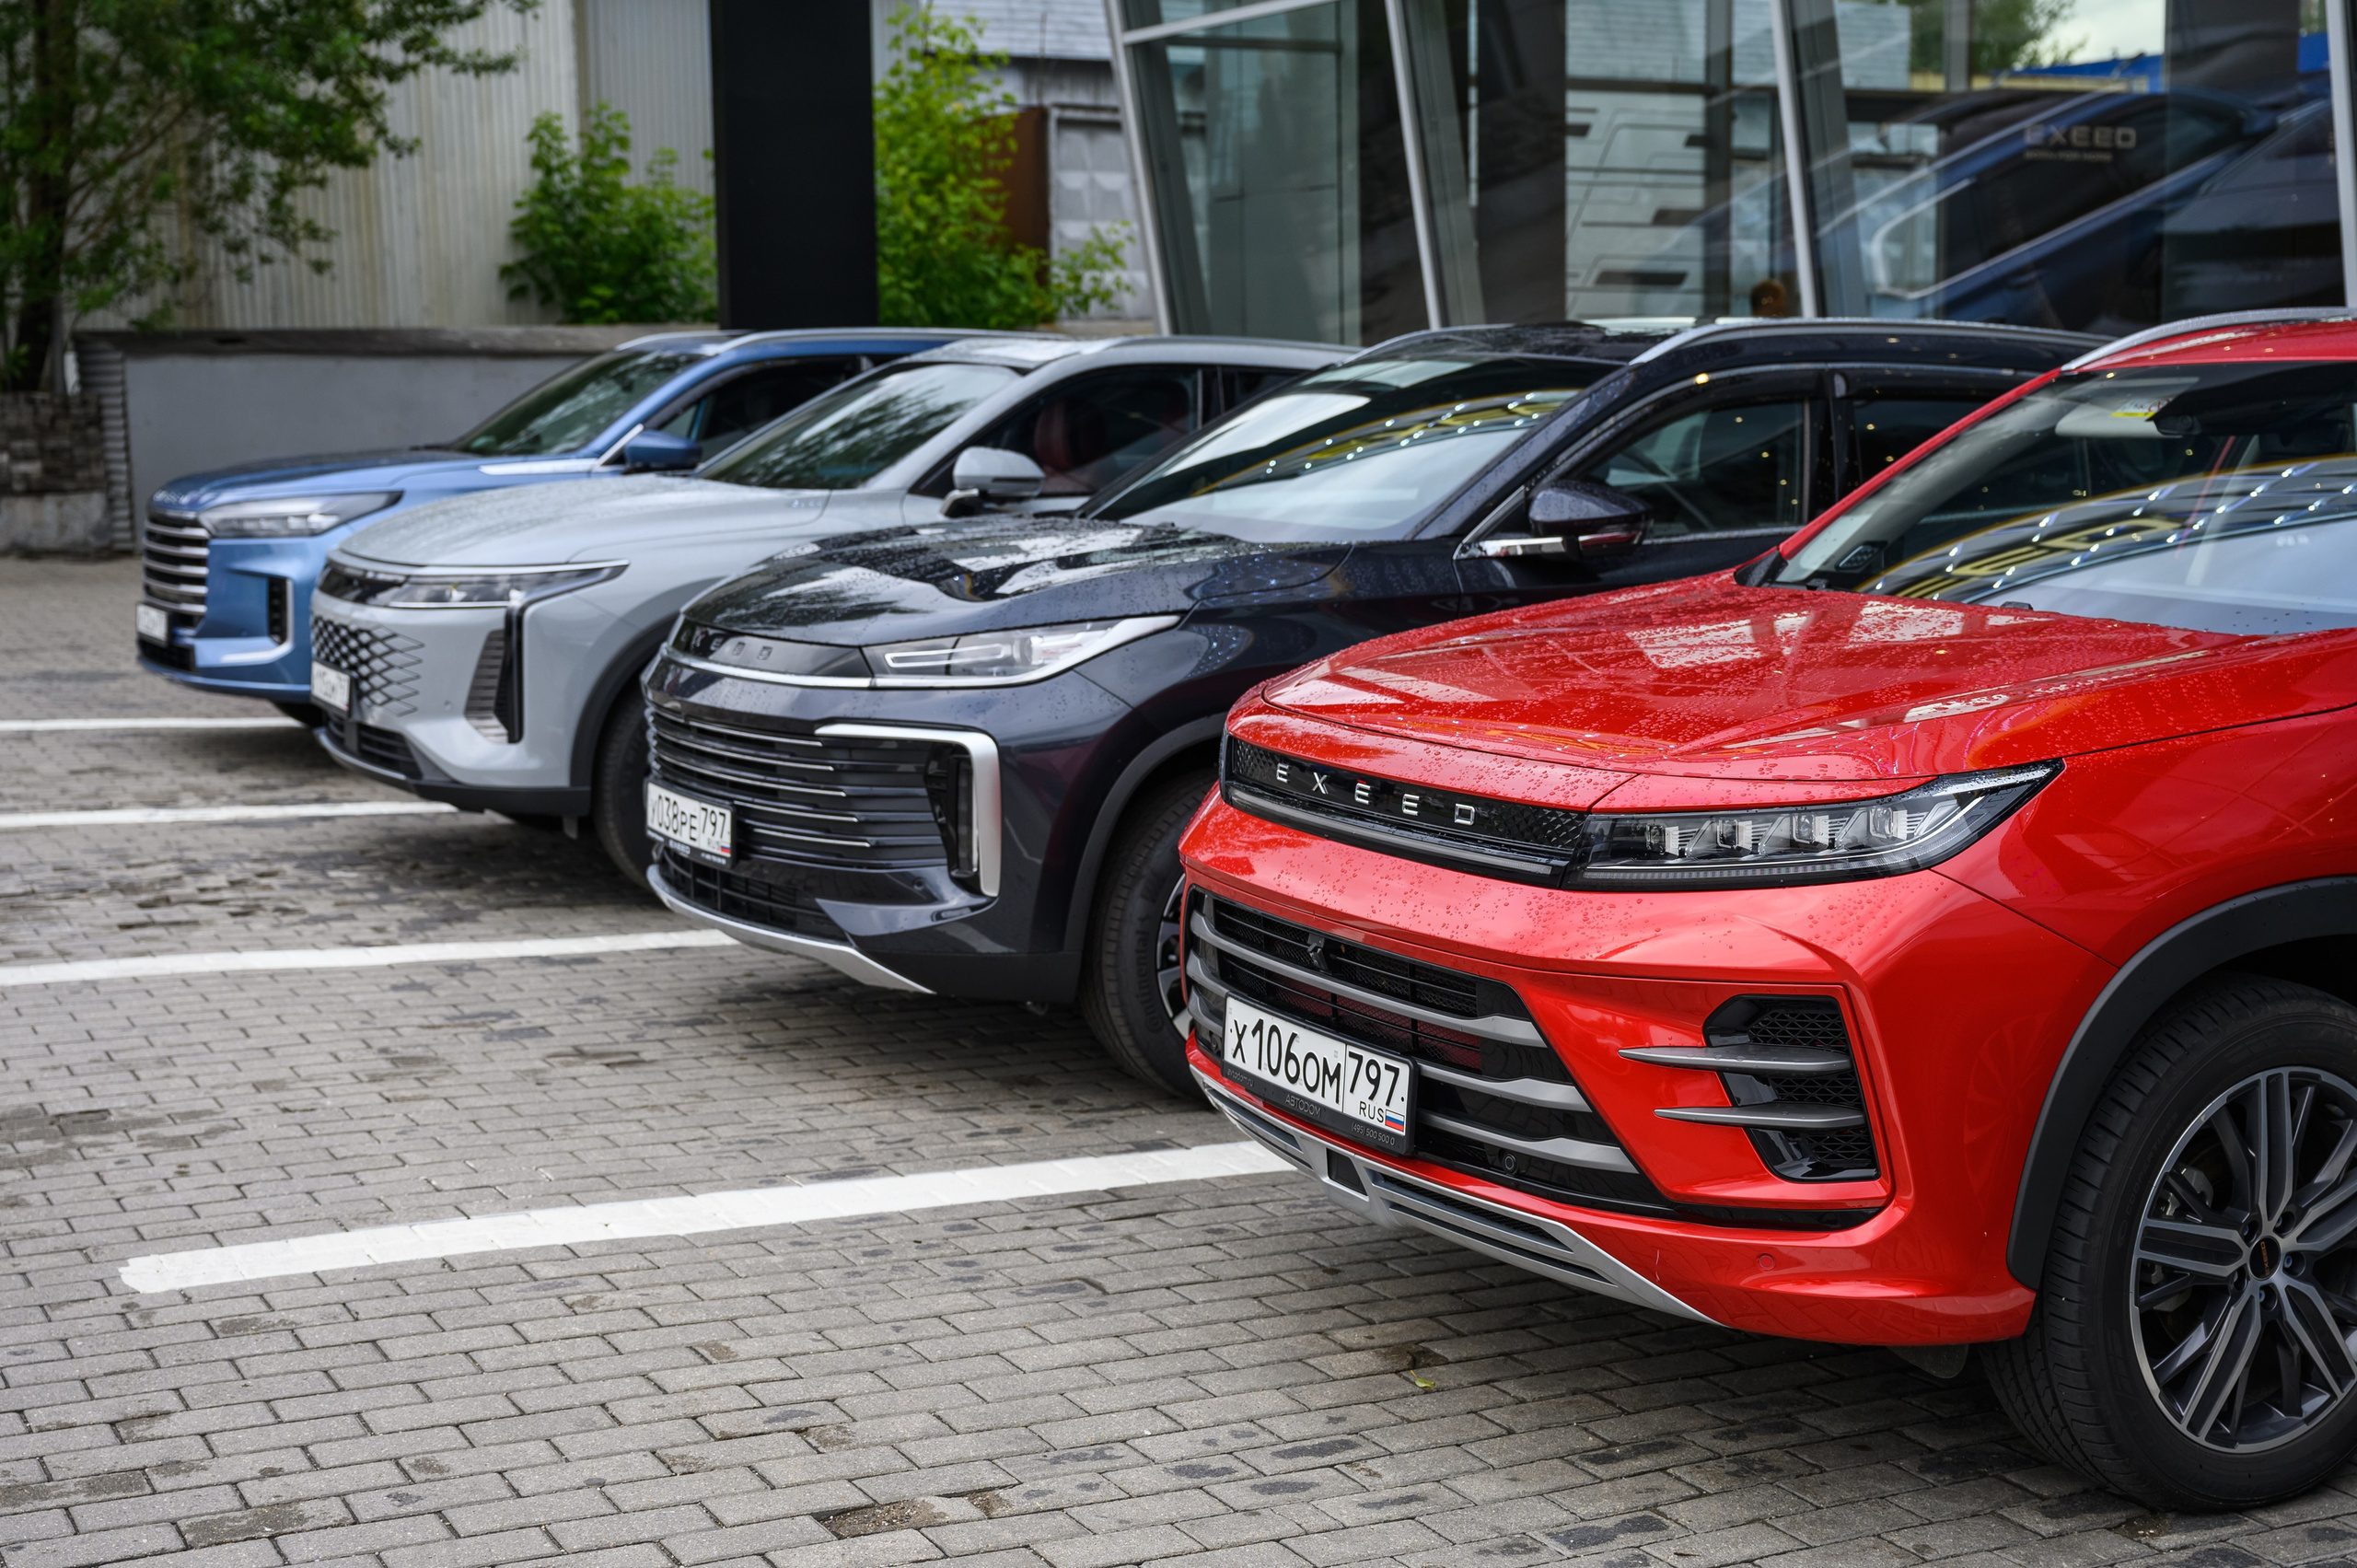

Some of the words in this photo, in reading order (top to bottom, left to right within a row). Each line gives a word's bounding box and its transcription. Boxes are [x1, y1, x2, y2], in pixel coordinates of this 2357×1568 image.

[1276, 762, 1476, 827] EXEED
[701, 807, 726, 839] 797
[1348, 1051, 1399, 1107] 797
[1359, 1101, 1385, 1123] RUS
[1351, 1121, 1365, 1136] (495)
[1365, 1128, 1377, 1140] 500
[1377, 1132, 1390, 1144] 500
[1390, 1136, 1395, 1146] 0
